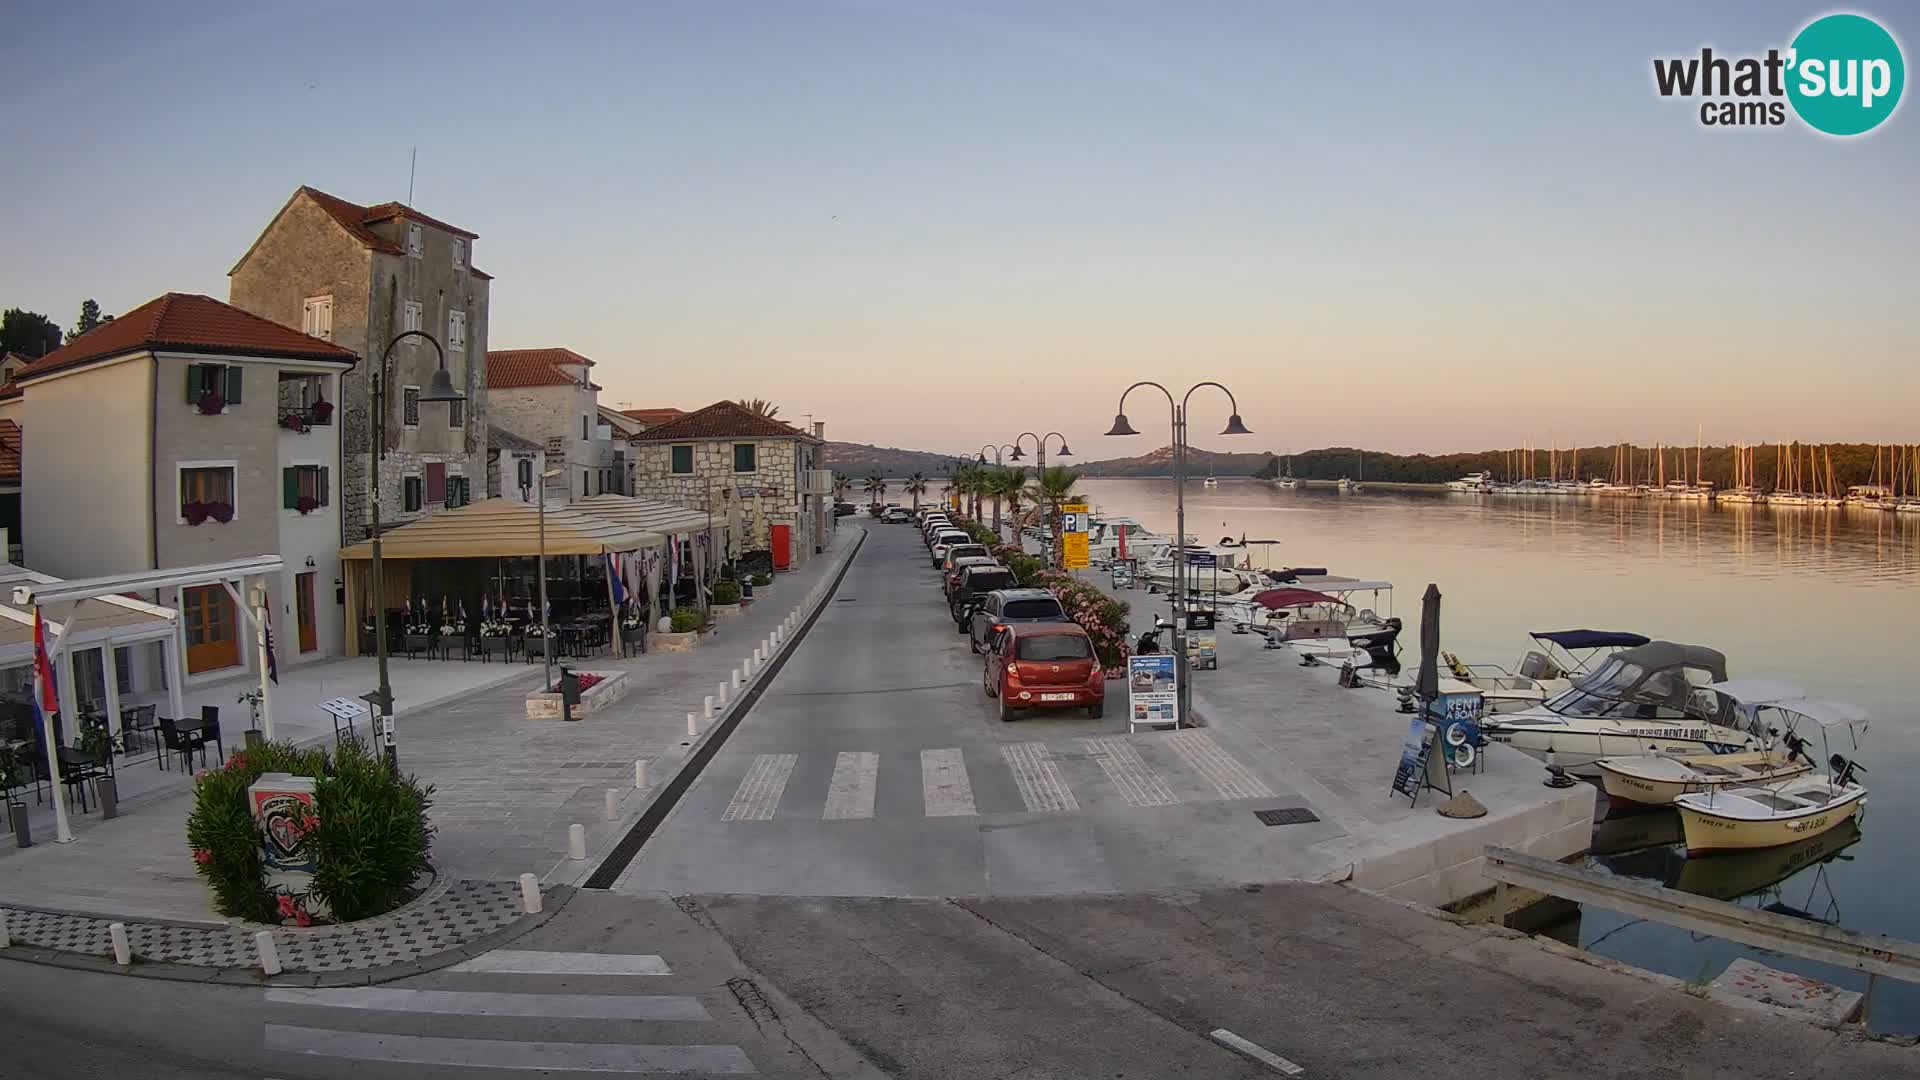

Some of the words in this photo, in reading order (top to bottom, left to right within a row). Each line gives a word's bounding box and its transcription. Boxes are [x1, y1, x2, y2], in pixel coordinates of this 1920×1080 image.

[1065, 515, 1076, 530] P
[1447, 698, 1480, 711] RENT
[1446, 710, 1453, 720] A
[1455, 710, 1480, 720] BOAT
[1663, 728, 1683, 738] RENT
[1683, 728, 1689, 738] A
[1690, 729, 1708, 740] BOAT
